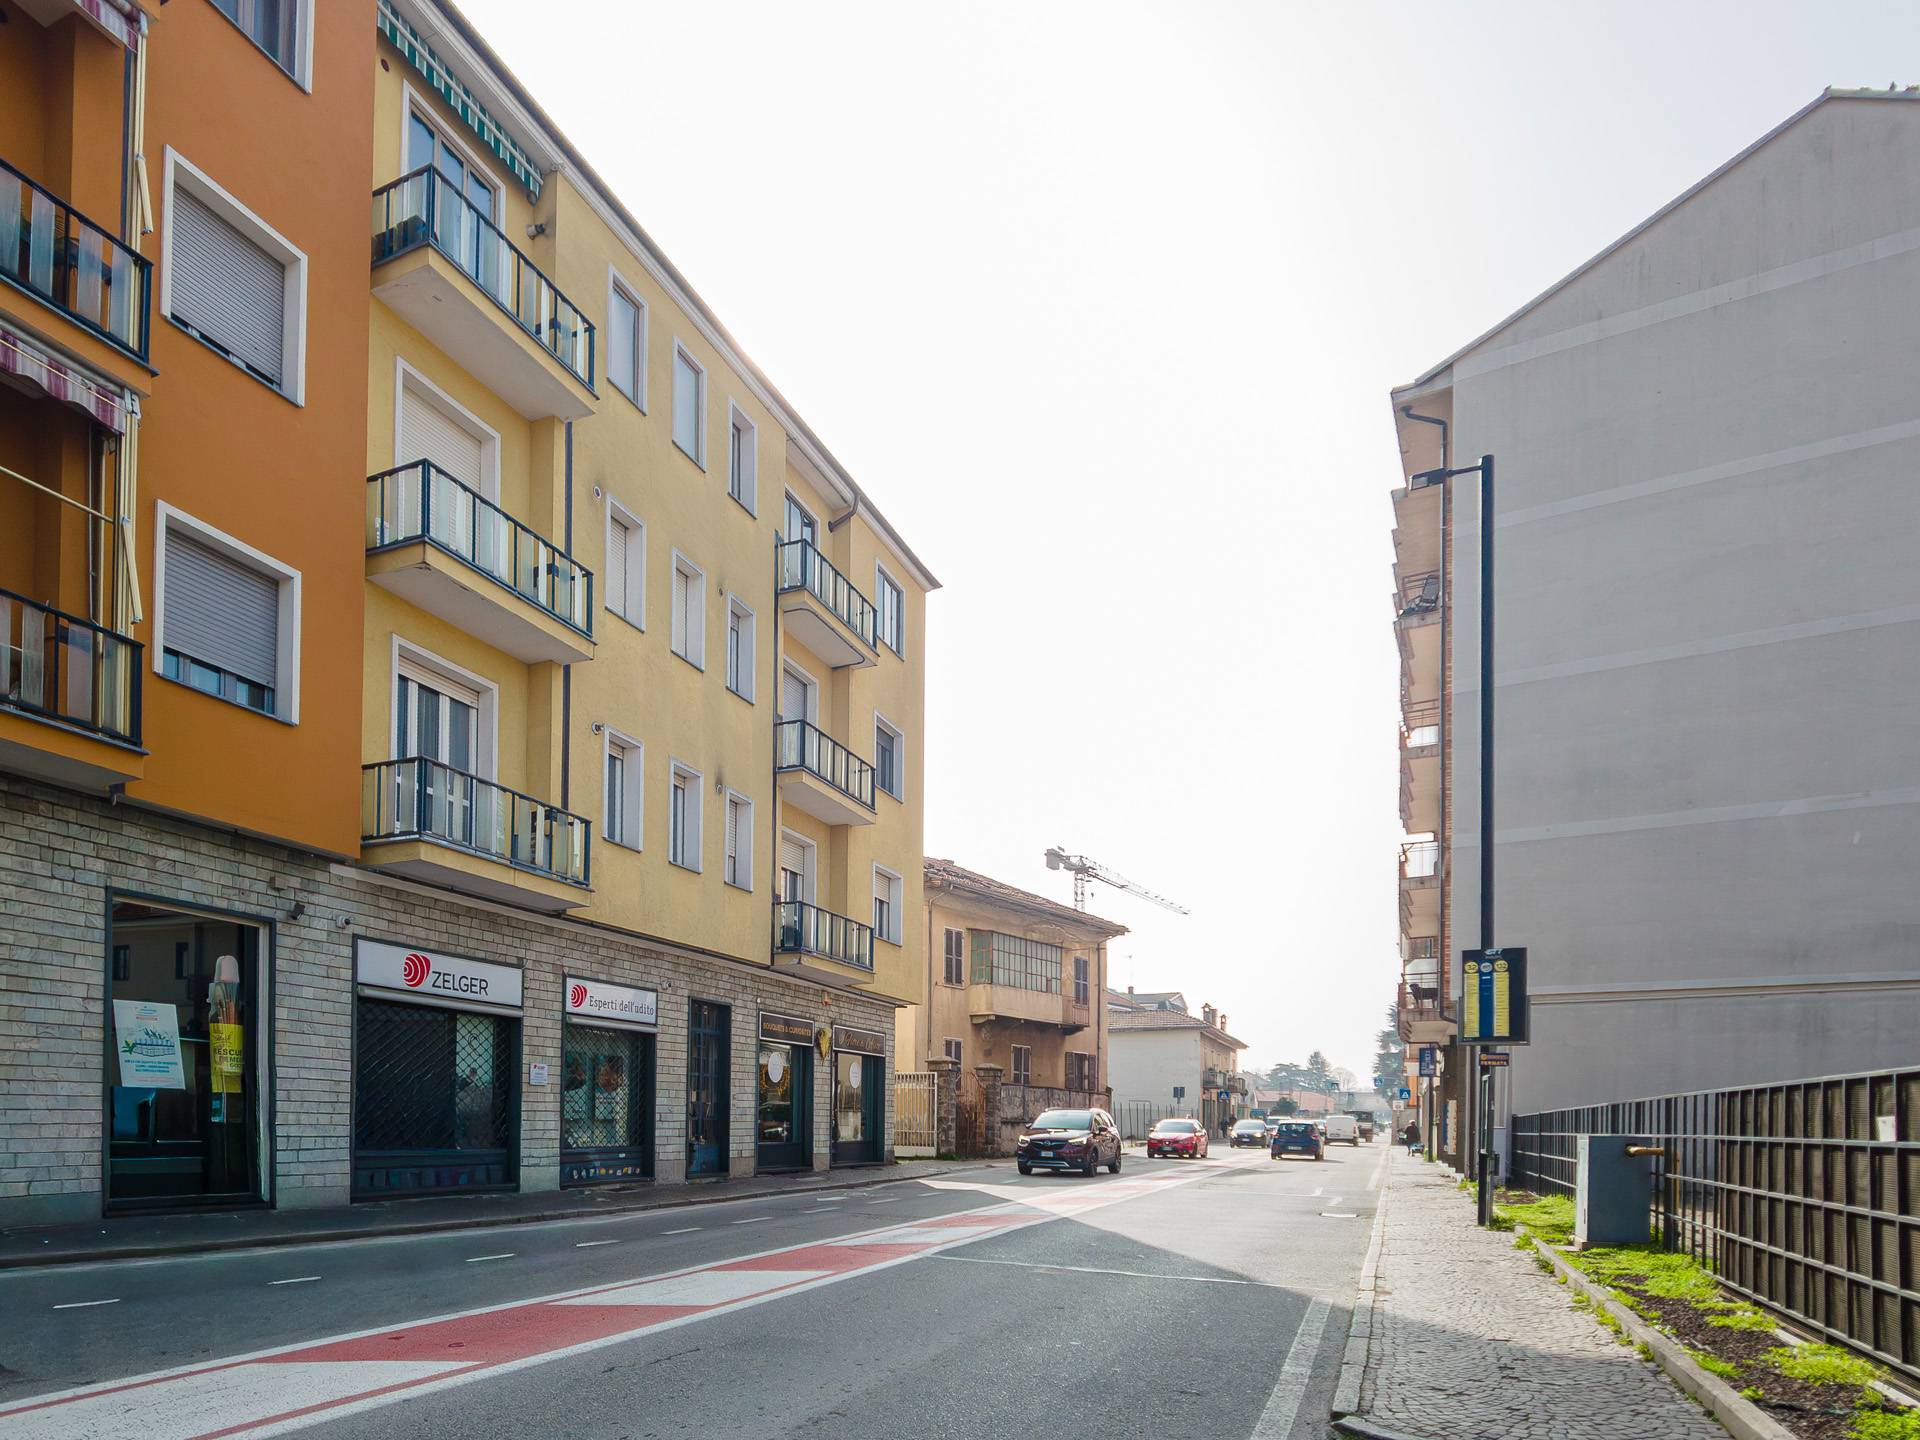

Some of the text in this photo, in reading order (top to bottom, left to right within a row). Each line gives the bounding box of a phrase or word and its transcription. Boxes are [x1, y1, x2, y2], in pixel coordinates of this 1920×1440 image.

[431, 970, 489, 996] ZELGER
[589, 995, 655, 1016] Esperti dell'udito
